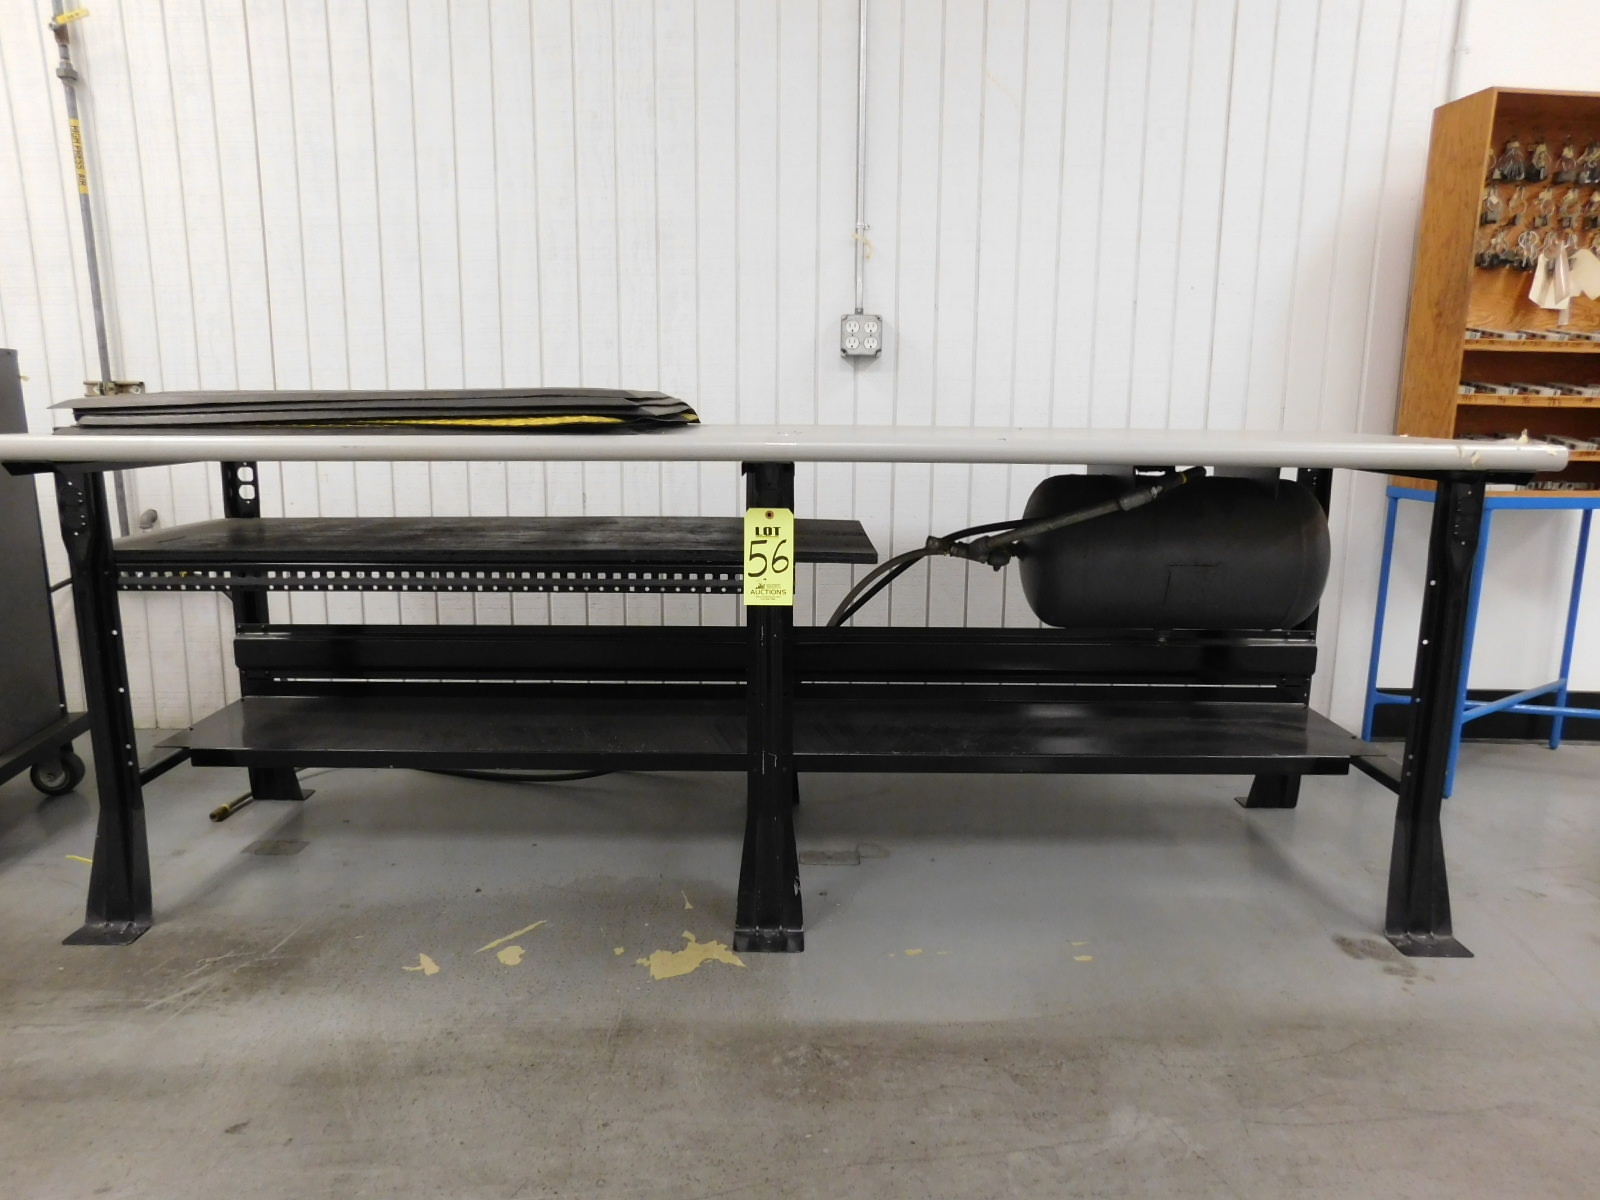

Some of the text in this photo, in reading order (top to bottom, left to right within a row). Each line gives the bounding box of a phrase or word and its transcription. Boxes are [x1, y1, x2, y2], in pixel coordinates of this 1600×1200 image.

[70, 125, 87, 186] HIGH PRESS AIR
[755, 526, 781, 536] LOT
[748, 539, 789, 577] 56
